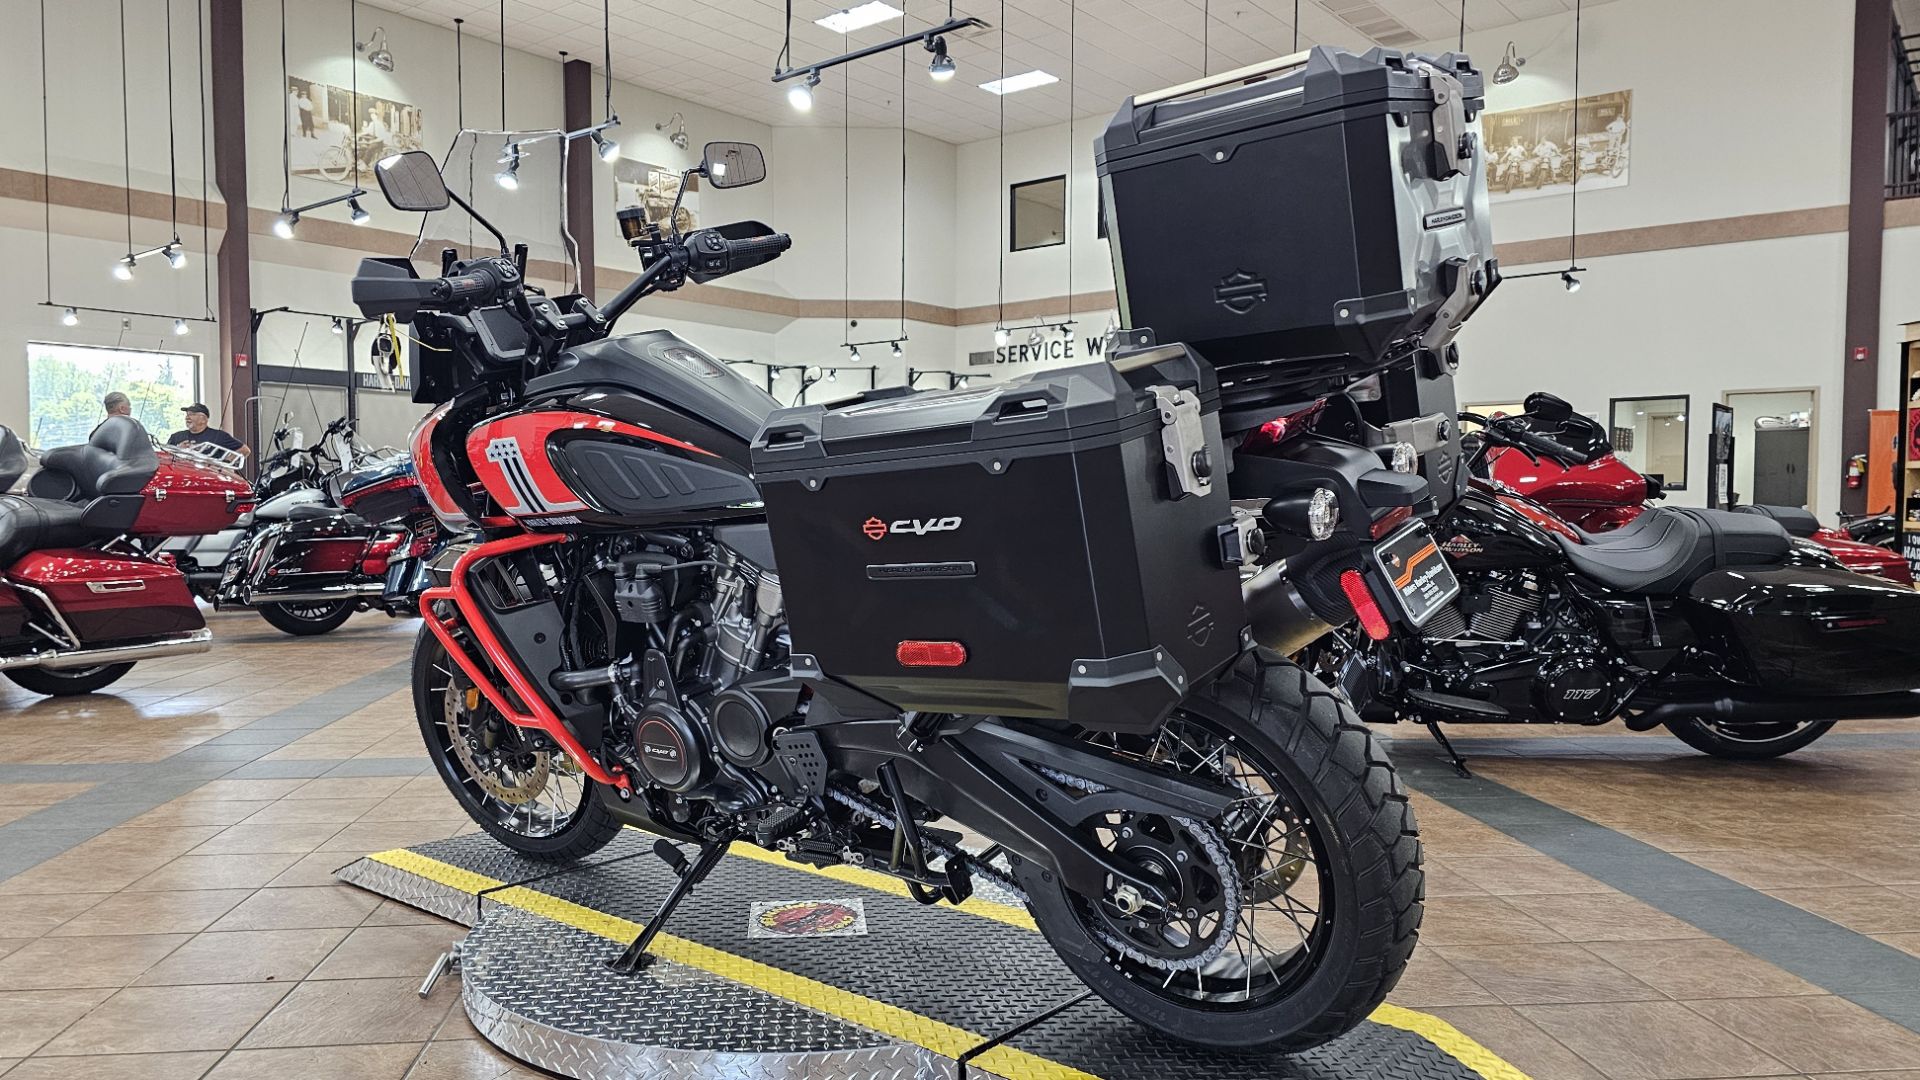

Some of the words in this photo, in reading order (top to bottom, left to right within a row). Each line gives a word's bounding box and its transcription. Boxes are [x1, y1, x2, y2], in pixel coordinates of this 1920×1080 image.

[996, 340, 1074, 363] SERVICE
[1086, 337, 1105, 356] W
[890, 517, 962, 535] CVO
[1563, 689, 1600, 699] 117
